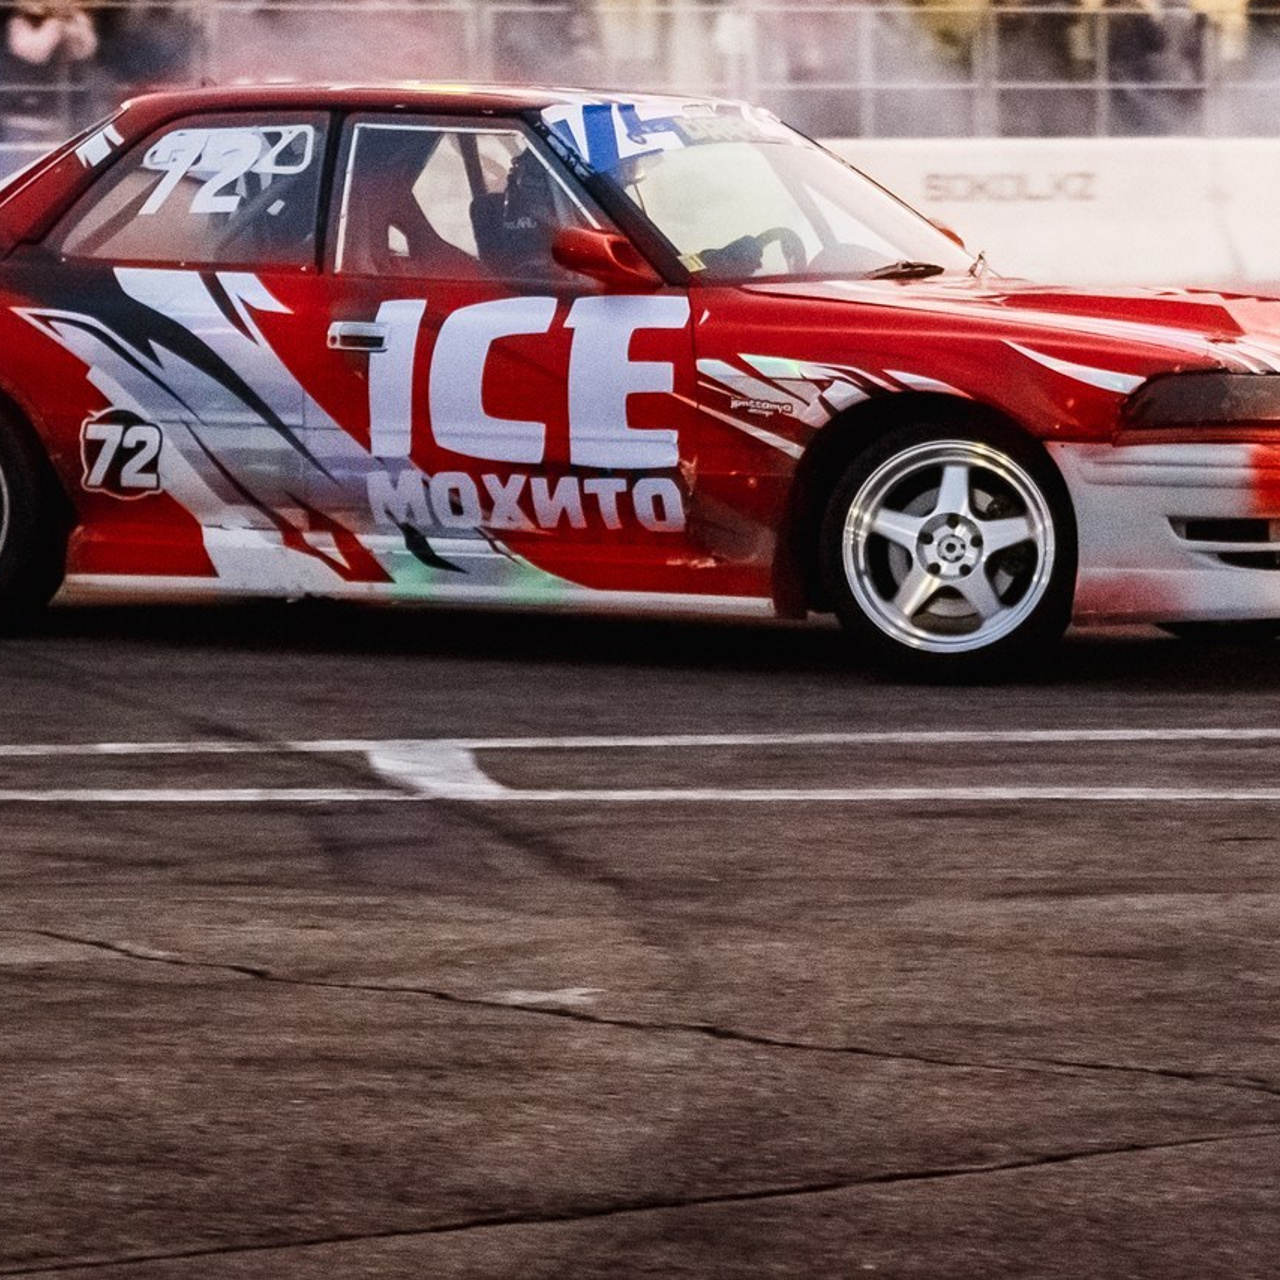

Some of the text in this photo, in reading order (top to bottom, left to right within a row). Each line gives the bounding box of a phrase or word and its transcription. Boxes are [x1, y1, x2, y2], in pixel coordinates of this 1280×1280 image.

[368, 296, 690, 469] ICE
[85, 424, 161, 488] 72
[366, 471, 686, 532] МОХИТО
